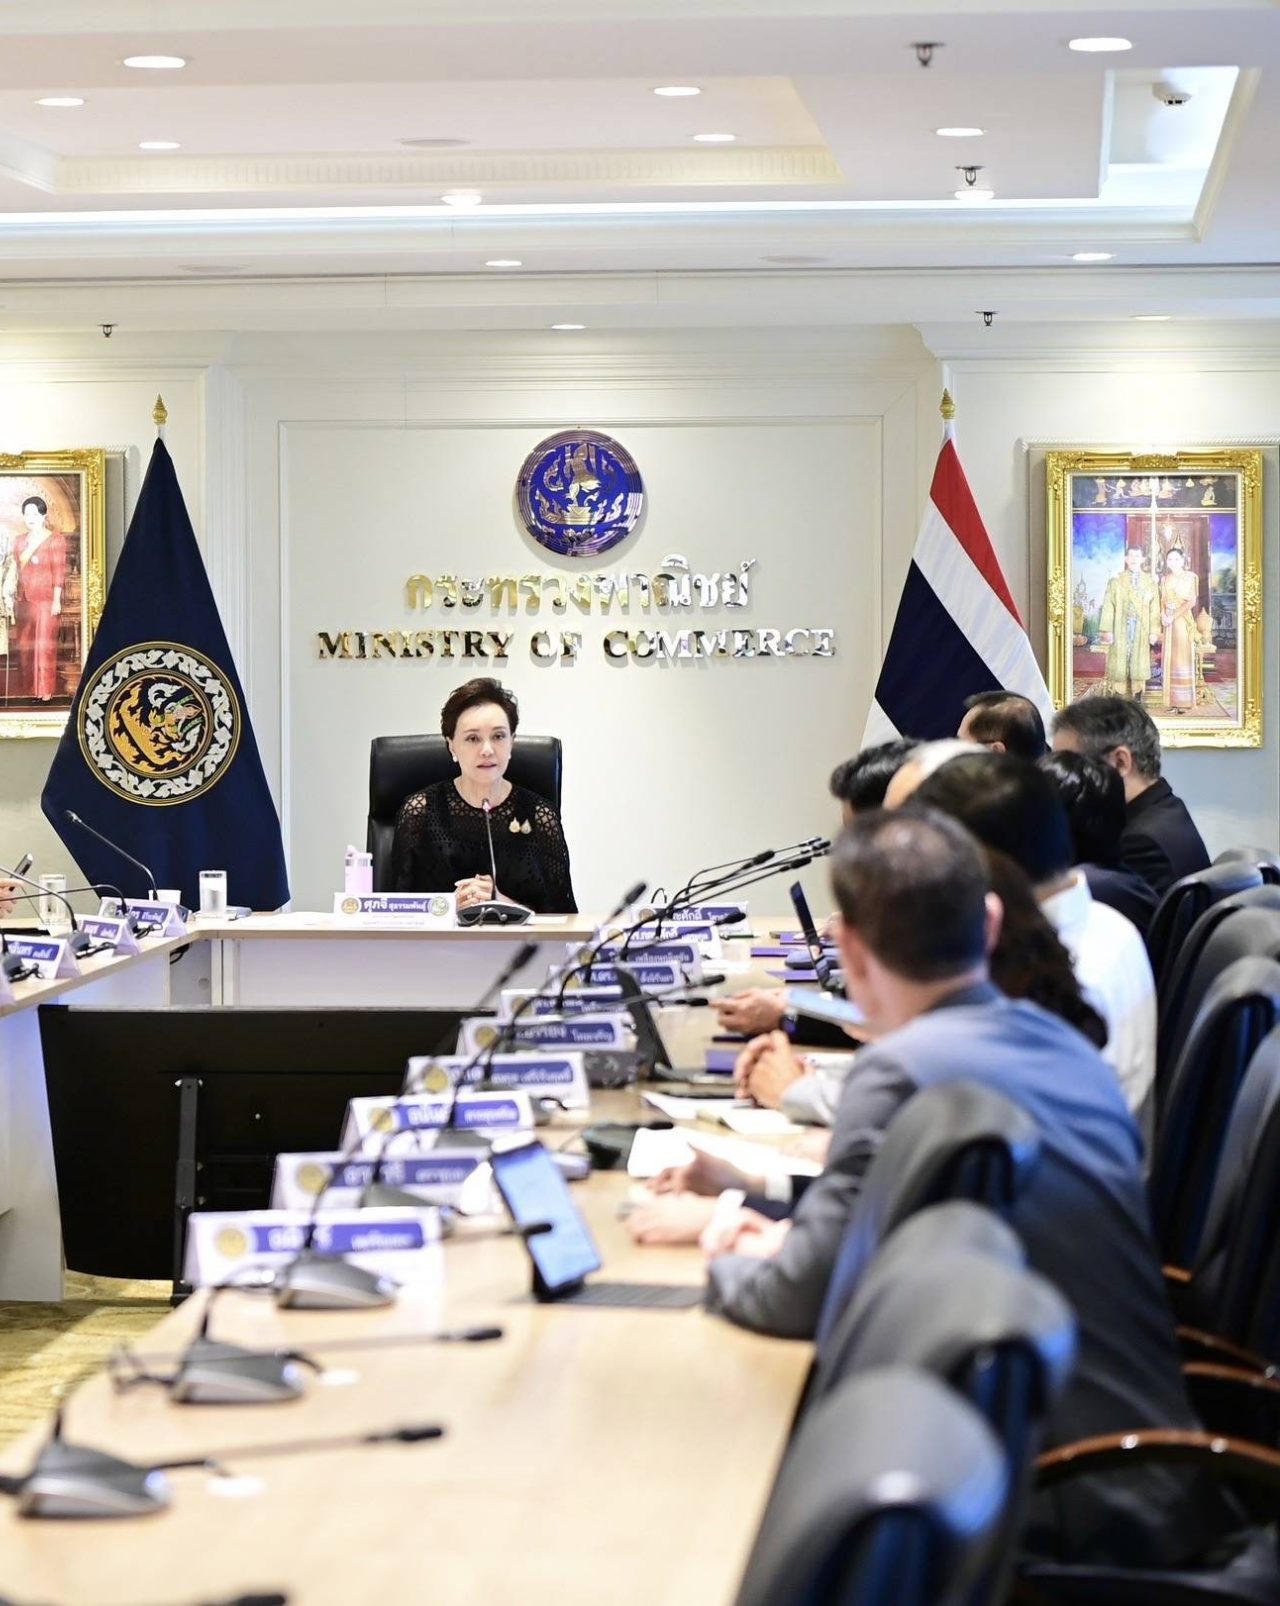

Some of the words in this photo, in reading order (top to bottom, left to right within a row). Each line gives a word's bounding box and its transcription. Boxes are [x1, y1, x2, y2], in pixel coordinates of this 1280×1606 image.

[405, 554, 756, 608] กระทรวงพาณิชย์
[317, 630, 514, 659] MINISTRY
[530, 630, 581, 658] OF
[602, 628, 835, 658] COMMERCE
